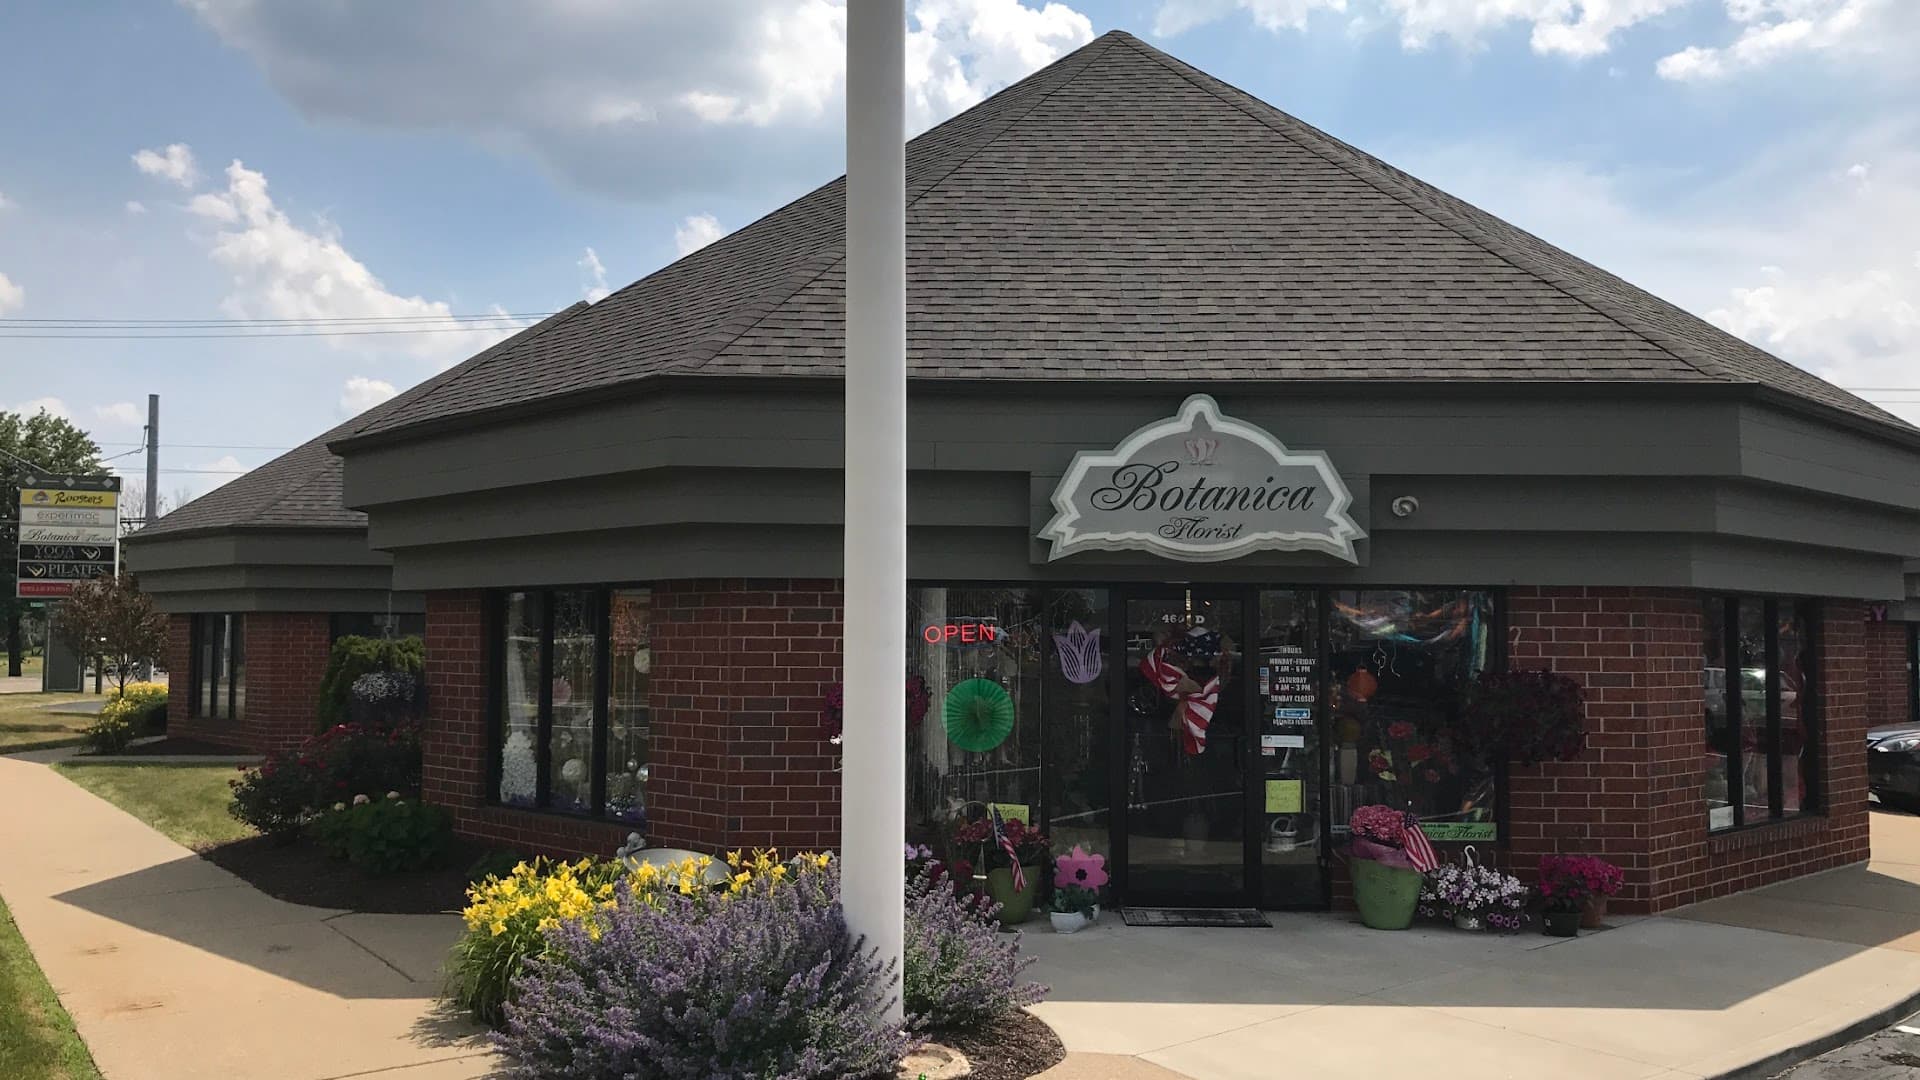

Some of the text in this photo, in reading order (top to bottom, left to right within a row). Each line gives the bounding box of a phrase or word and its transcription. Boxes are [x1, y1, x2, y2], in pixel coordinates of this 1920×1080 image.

[1090, 460, 1317, 511] Botanica
[54, 491, 104, 504] Roosters
[1158, 516, 1243, 539] Florist
[23, 528, 81, 542] Botanica
[34, 546, 76, 556] YOGA
[48, 563, 105, 575] PILATES
[925, 624, 996, 643] OPEN
[1447, 825, 1494, 838] Florist
